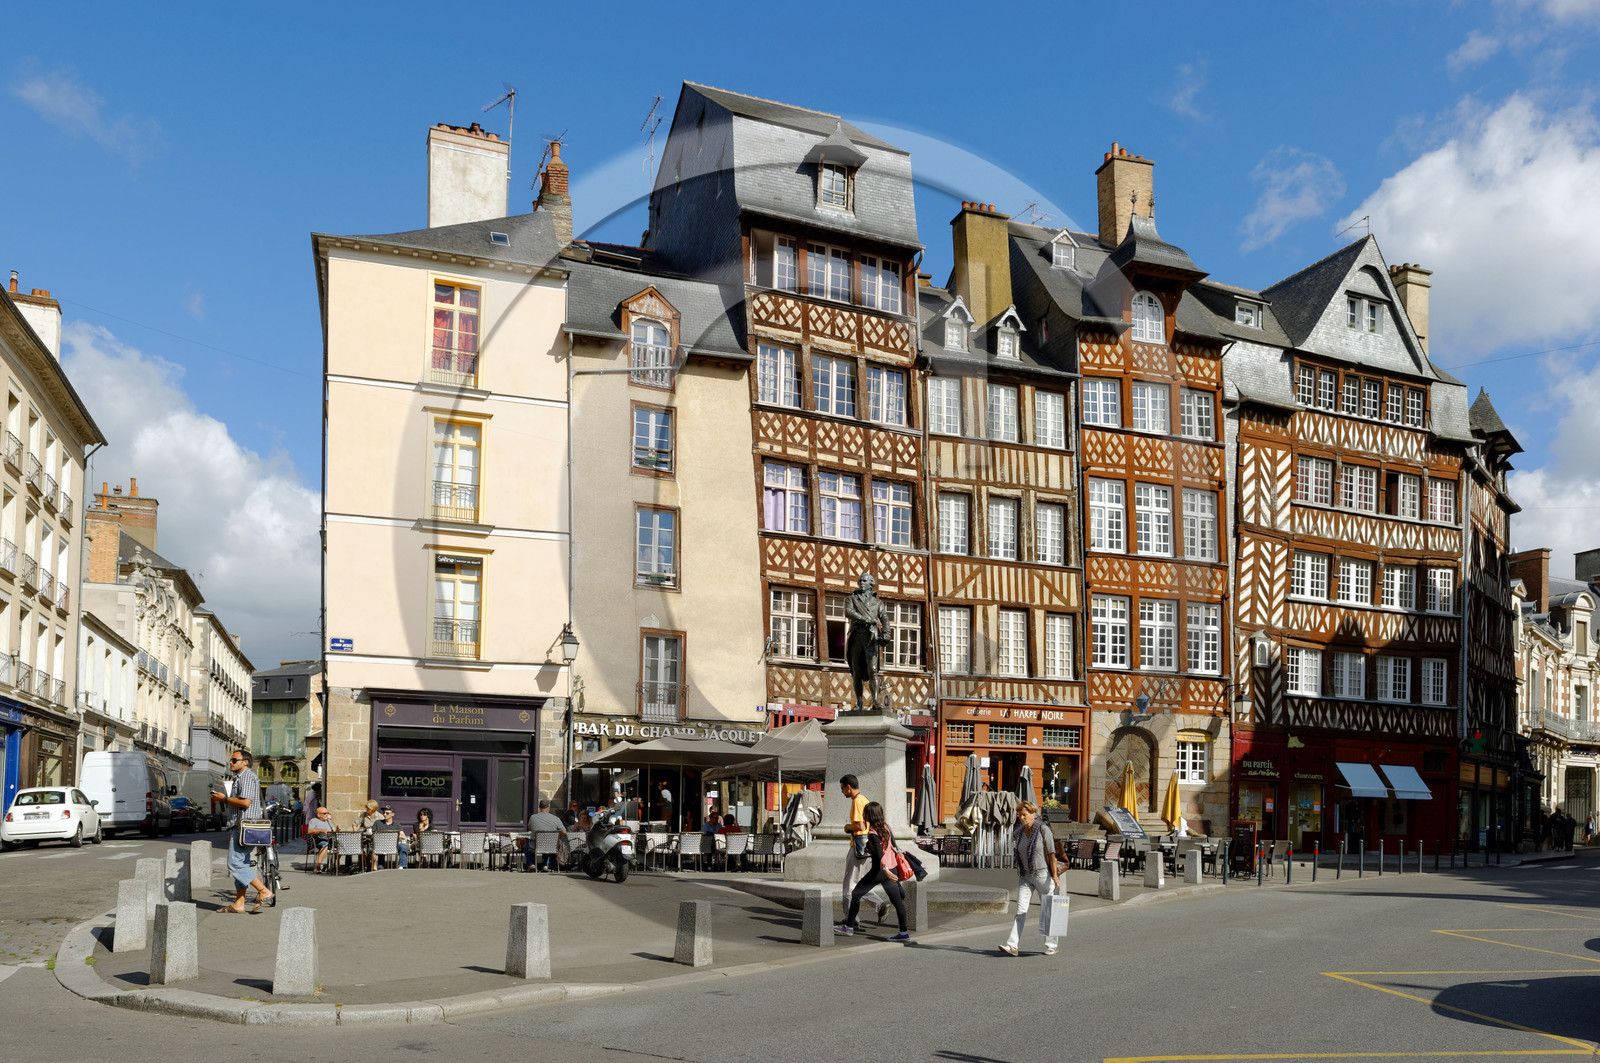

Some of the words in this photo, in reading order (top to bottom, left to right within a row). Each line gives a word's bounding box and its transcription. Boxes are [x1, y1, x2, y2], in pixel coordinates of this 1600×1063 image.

[433, 703, 446, 713] La
[449, 704, 484, 714] Maison
[432, 714, 445, 723] du
[449, 714, 484, 725] Parfum
[1013, 710, 1037, 719] HARPE
[1041, 711, 1064, 720] NOIRE
[577, 722, 610, 736] BAR
[614, 724, 635, 736] DU
[388, 776, 413, 786] TOM
[414, 776, 445, 786] FORD
